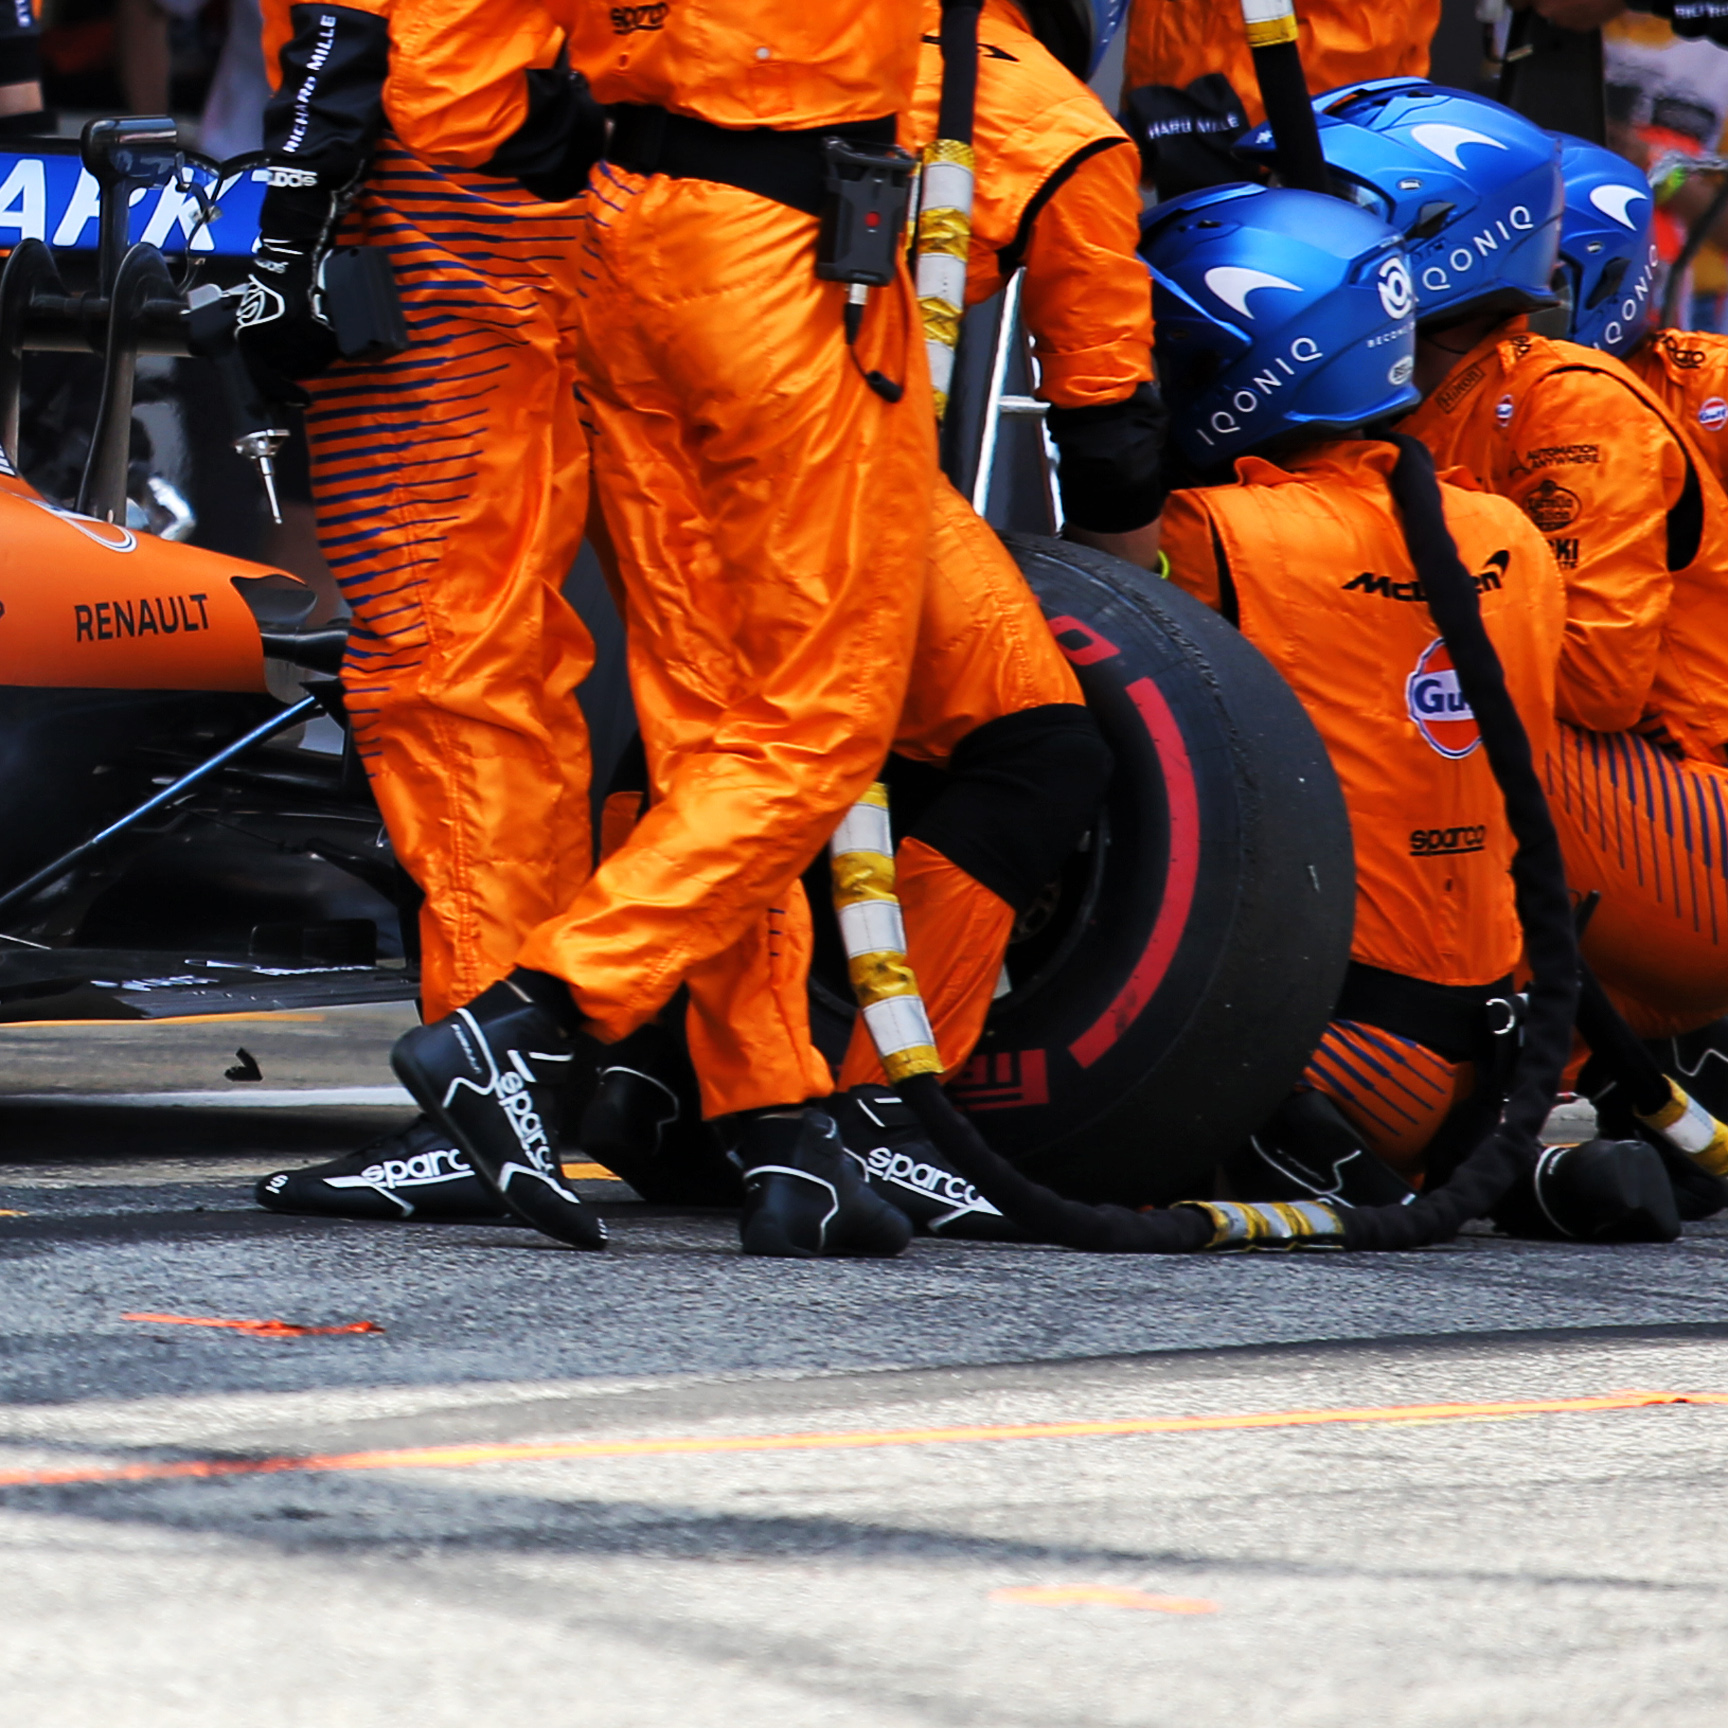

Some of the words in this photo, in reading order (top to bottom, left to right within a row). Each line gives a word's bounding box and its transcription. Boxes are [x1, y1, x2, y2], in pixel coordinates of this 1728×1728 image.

[1197, 335, 1324, 447] IQONIQ
[73, 593, 210, 644] RENAULT
[1410, 823, 1487, 855] sparco
[360, 1148, 472, 1188] sparc
